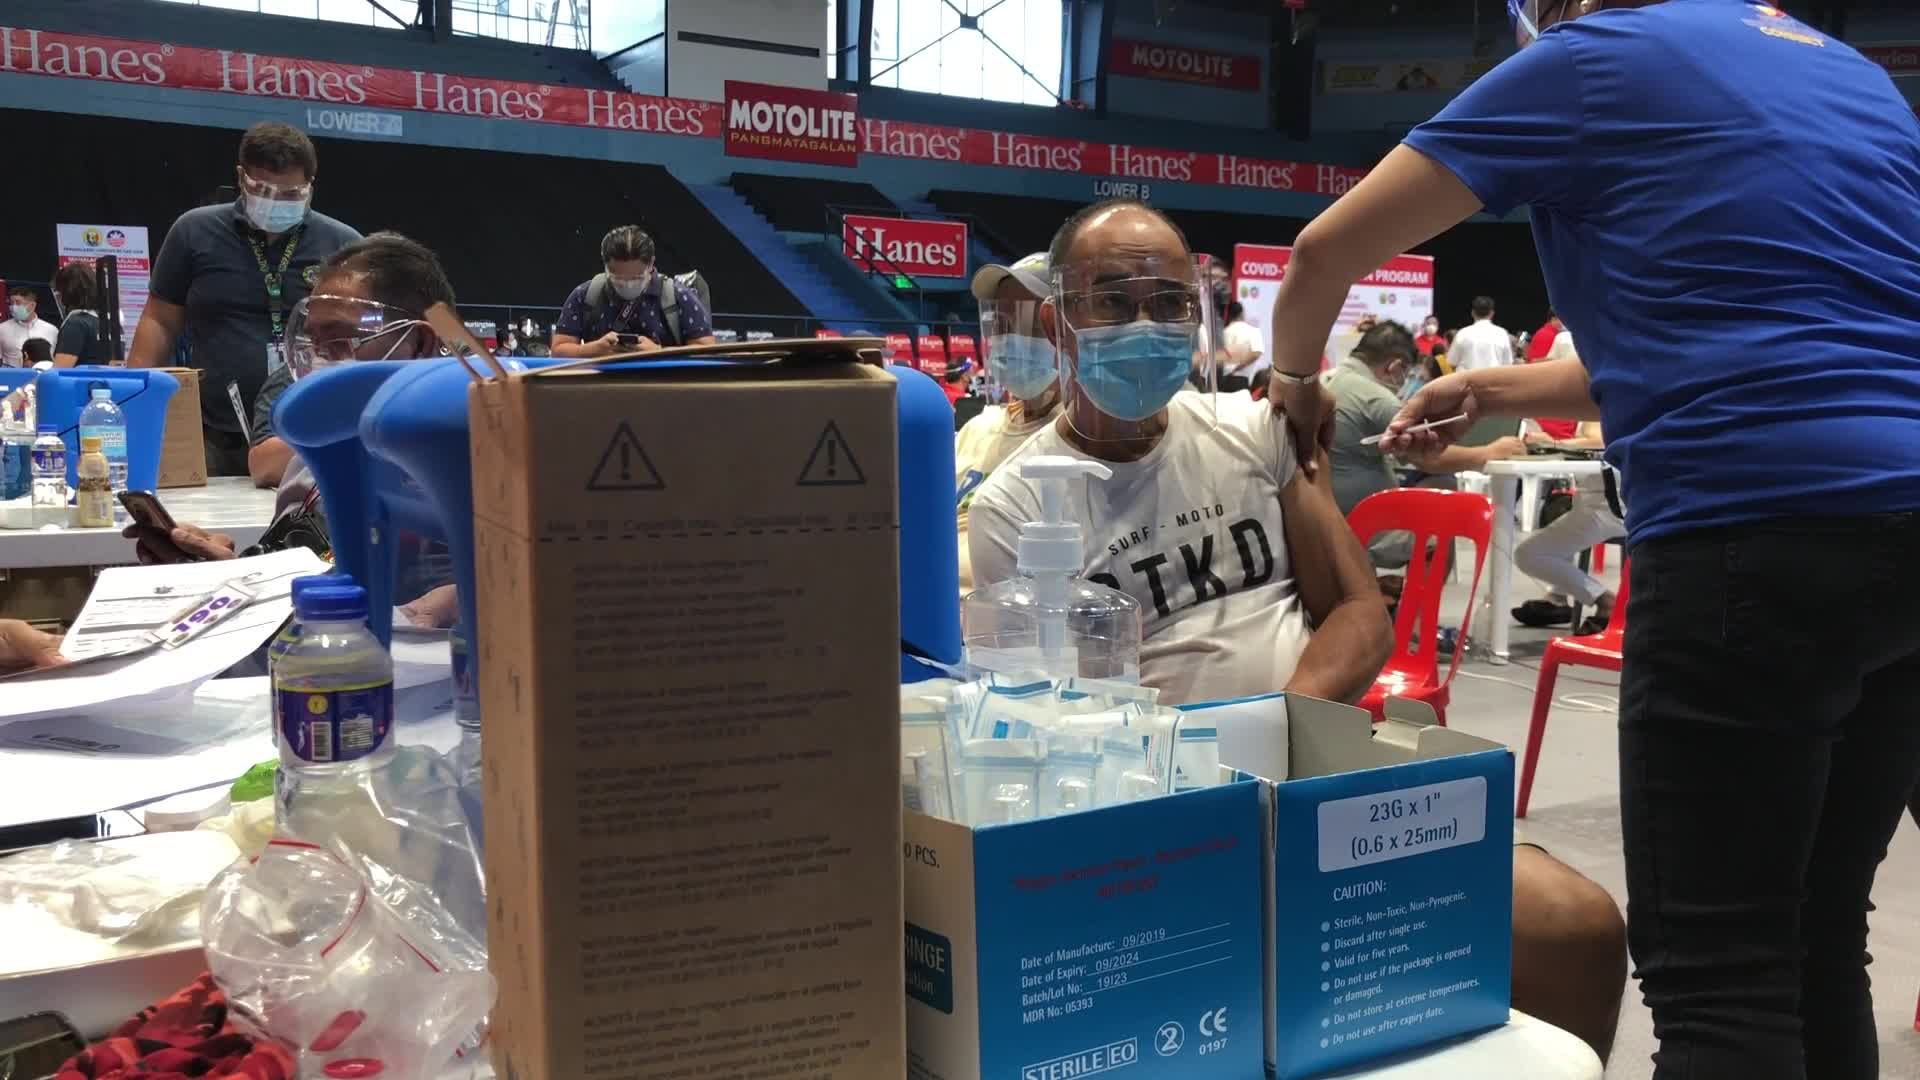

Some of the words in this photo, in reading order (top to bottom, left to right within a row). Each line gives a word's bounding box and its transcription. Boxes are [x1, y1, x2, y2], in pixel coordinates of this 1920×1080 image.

[1131, 44, 1234, 78] MOTOLITE
[307, 107, 379, 131] LOWER
[729, 98, 857, 141] MOTOLITE
[1093, 181, 1136, 199] LOWER
[1141, 184, 1150, 200] B
[1375, 269, 1430, 285] PROGRAM
[1108, 526, 1150, 556] SURF
[1175, 504, 1225, 527] MOTO
[175, 596, 231, 632] 190
[1370, 799, 1403, 823] 23G
[1409, 801, 1418, 815] x
[1424, 792, 1441, 813] 1"
[1352, 834, 1384, 860] (0.6
[1389, 835, 1399, 849] x
[1404, 818, 1458, 847] 25mm)
[915, 844, 941, 868] PCS.
[1333, 879, 1387, 901] CAUTION:
[1334, 916, 1364, 930] Sterile,
[1366, 904, 1408, 923] Non-Toxic,
[1021, 957, 1042, 970] Date
[1044, 953, 1054, 964] of
[1056, 940, 1116, 962] Manufacture:
[1122, 928, 1166, 948] 09/2019
[1334, 934, 1365, 950] Discard
[1366, 928, 1386, 943] after
[1388, 924, 1410, 938] single
[1413, 920, 1428, 931] use.
[1021, 975, 1042, 989] Date
[1045, 971, 1054, 982] of
[1057, 963, 1087, 981] Expiry:
[1095, 951, 1140, 972] 09/2024
[1334, 955, 1355, 969] Valid
[1357, 952, 1369, 964] for
[1371, 947, 1386, 960] five
[1388, 943, 1410, 959] years.
[1334, 978, 1346, 989] Do
[1348, 974, 1362, 986] not
[1364, 971, 1377, 982] use
[1379, 965, 1386, 978] if
[1388, 964, 1401, 976] the
[1403, 957, 1434, 975] package
[1436, 953, 1443, 963] is
[1444, 944, 1472, 962] opened
[1022, 989, 1064, 1008] Batch/Lot
[1067, 983, 1083, 995] No:
[1334, 995, 1343, 1005] or
[1345, 983, 1384, 1003] damaged.
[1334, 1015, 1345, 1025] Do
[1347, 1011, 1361, 1022] not
[1363, 1005, 1384, 1017] store
[1385, 1000, 1393, 1010] at
[1396, 994, 1427, 1008] extreme
[1429, 978, 1480, 999] temperatures.
[1023, 1008, 1045, 1025] MDR
[1047, 1005, 1063, 1018] No:
[1065, 997, 1093, 1014] 05393
[1199, 1006, 1228, 1036] CE
[1332, 1034, 1343, 1045] Do
[1346, 1030, 1360, 1042] not
[1363, 1026, 1376, 1037] use
[1378, 1019, 1398, 1033] after
[1400, 1012, 1424, 1028] expiry
[1425, 1006, 1444, 1019] date.
[1024, 1052, 1104, 1080] STERILE
[1110, 1043, 1135, 1066] EO
[1199, 1037, 1228, 1056] 0197
